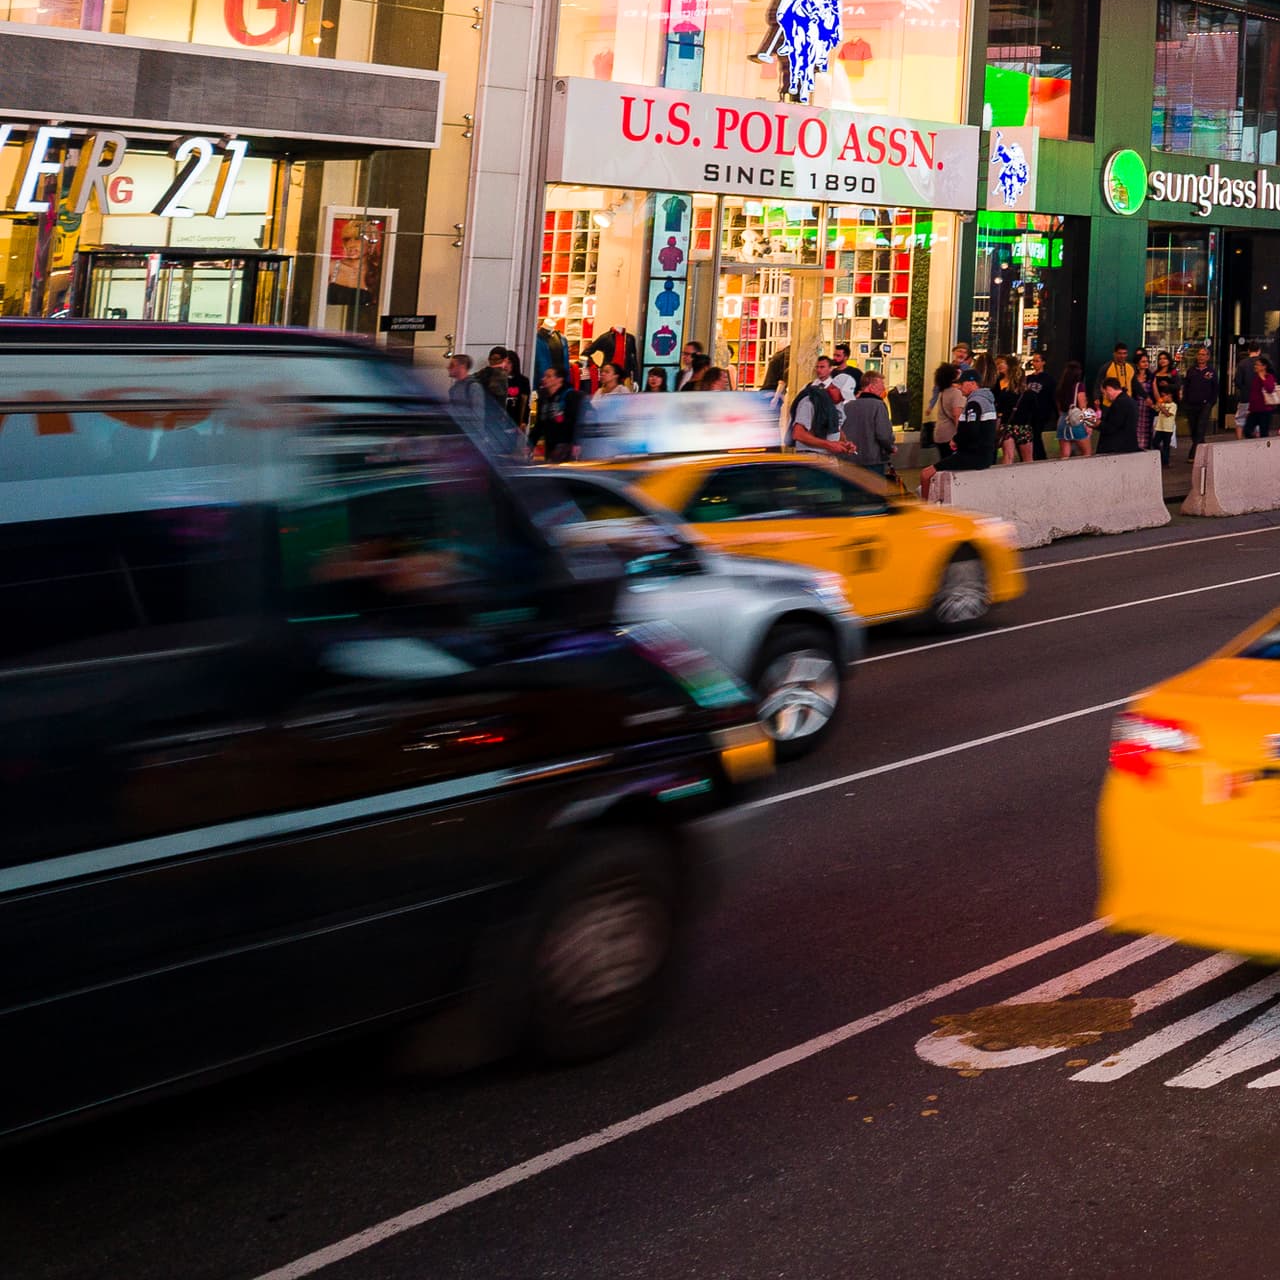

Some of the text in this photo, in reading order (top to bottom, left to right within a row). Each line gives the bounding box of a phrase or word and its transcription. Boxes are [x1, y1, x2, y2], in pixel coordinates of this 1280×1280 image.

[620, 95, 944, 172] U.S. POLO ASSN.
[157, 136, 249, 220] 21
[703, 163, 876, 194] SINCE 1890
[1152, 163, 1256, 217] sunglass
